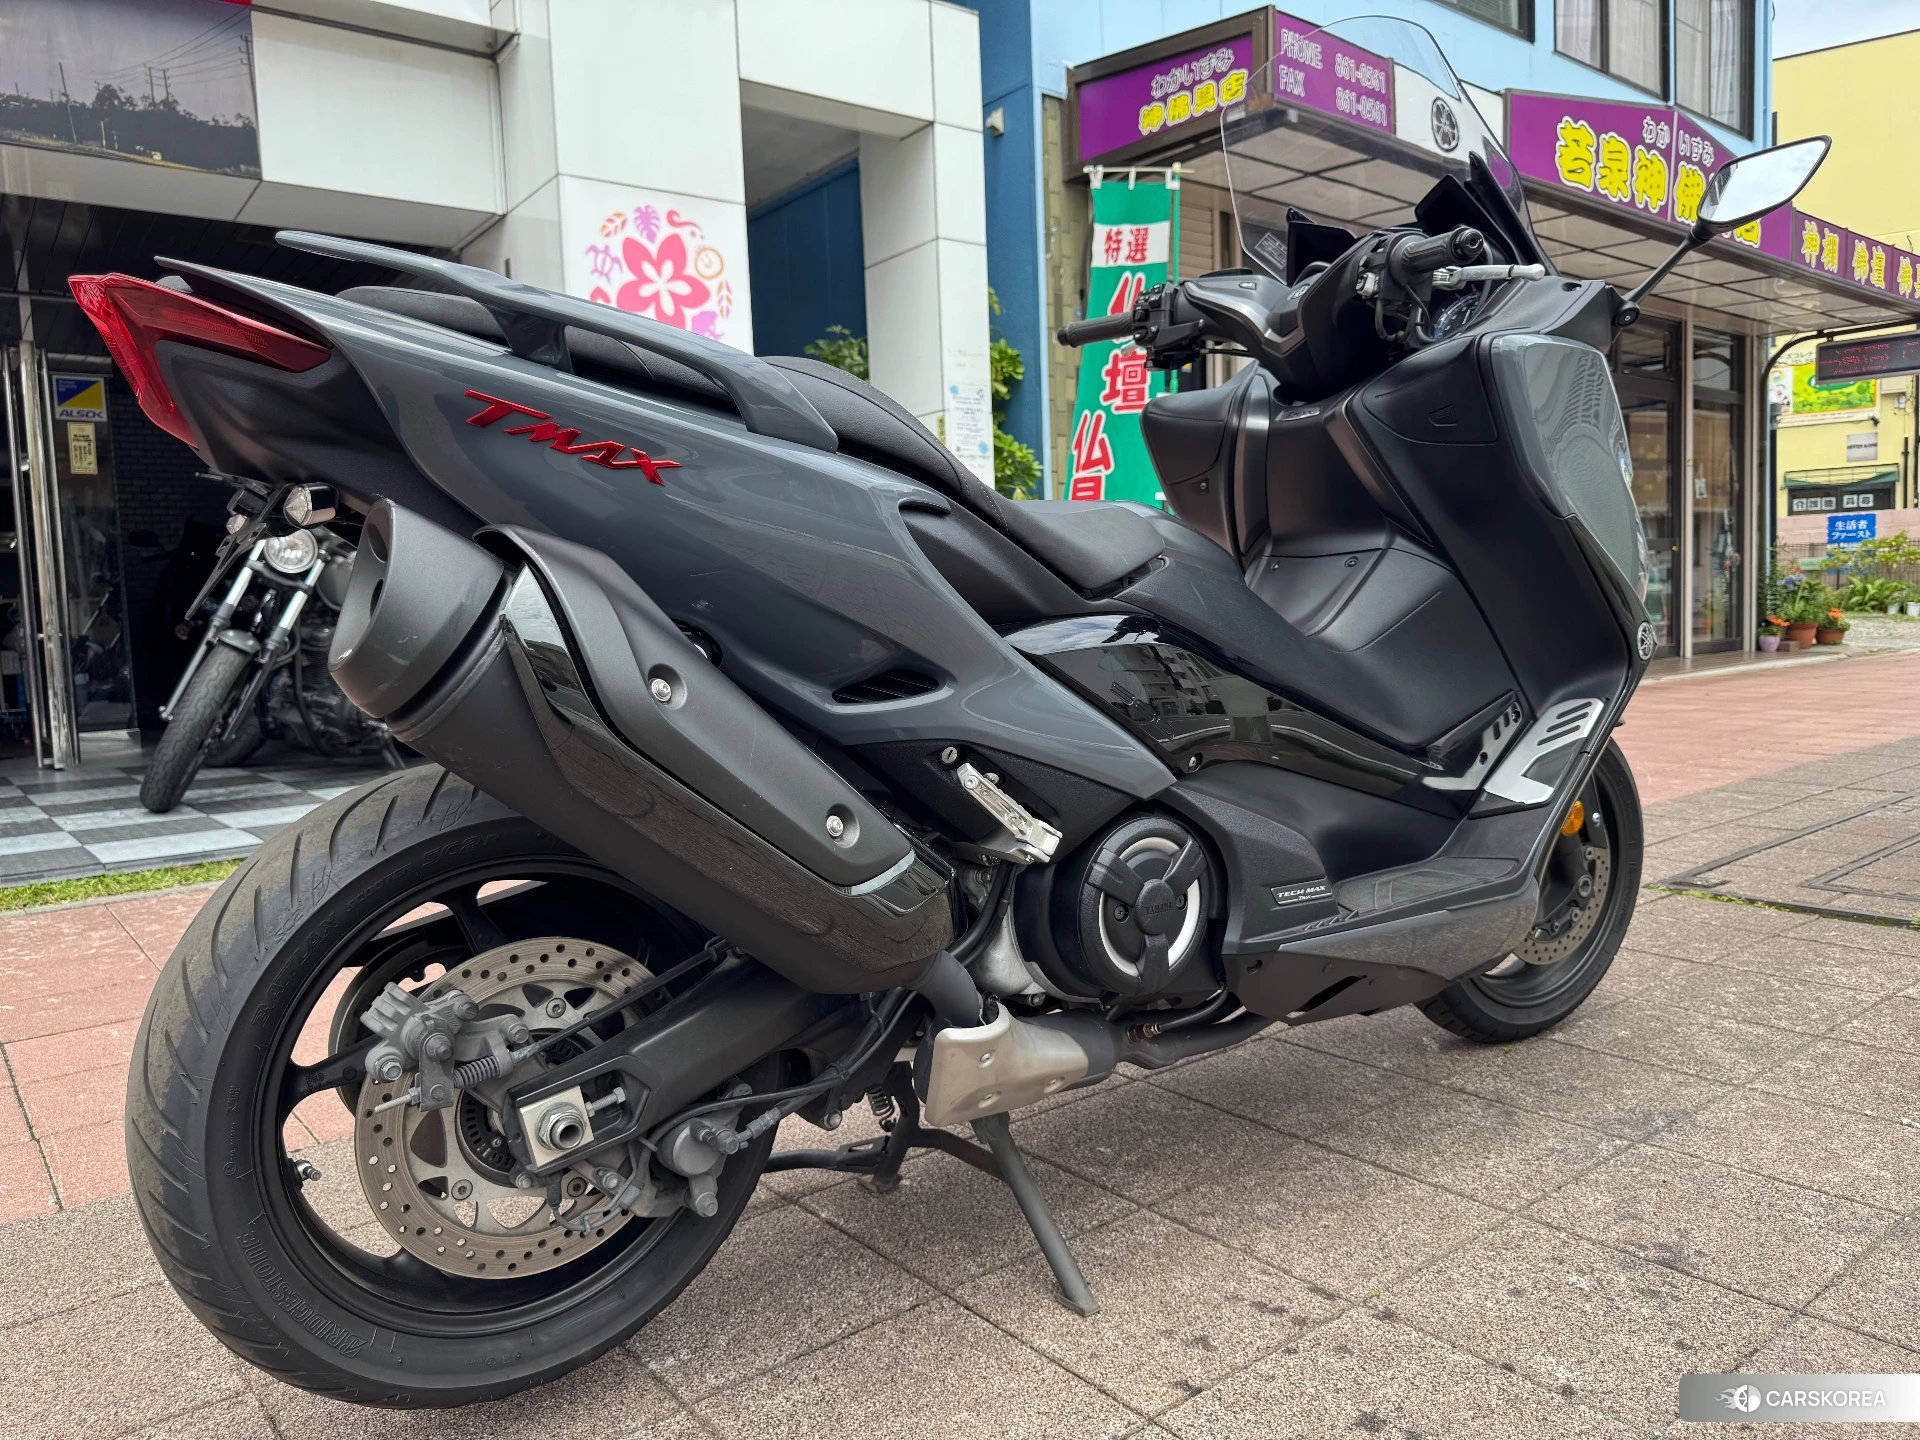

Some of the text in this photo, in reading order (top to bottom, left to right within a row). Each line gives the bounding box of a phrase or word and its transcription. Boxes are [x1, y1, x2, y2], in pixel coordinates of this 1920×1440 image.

[1151, 48, 1235, 99] わかいずみ
[1281, 28, 1387, 94] PHONE 861-0561
[1279, 65, 1388, 126] FAX 861-0561
[1642, 115, 1715, 168] わかいずみ
[1104, 227, 1149, 265] 特選
[59, 409, 103, 419] ALSOK
[464, 389, 683, 486] TMAX
[1831, 530, 1871, 540] ファースト
[1834, 519, 1868, 531] 生活者
[1145, 901, 1173, 916] YAMAHA
[1277, 885, 1326, 898] TECH MAX
[236, 1230, 368, 1359] BRIDGESTONE
